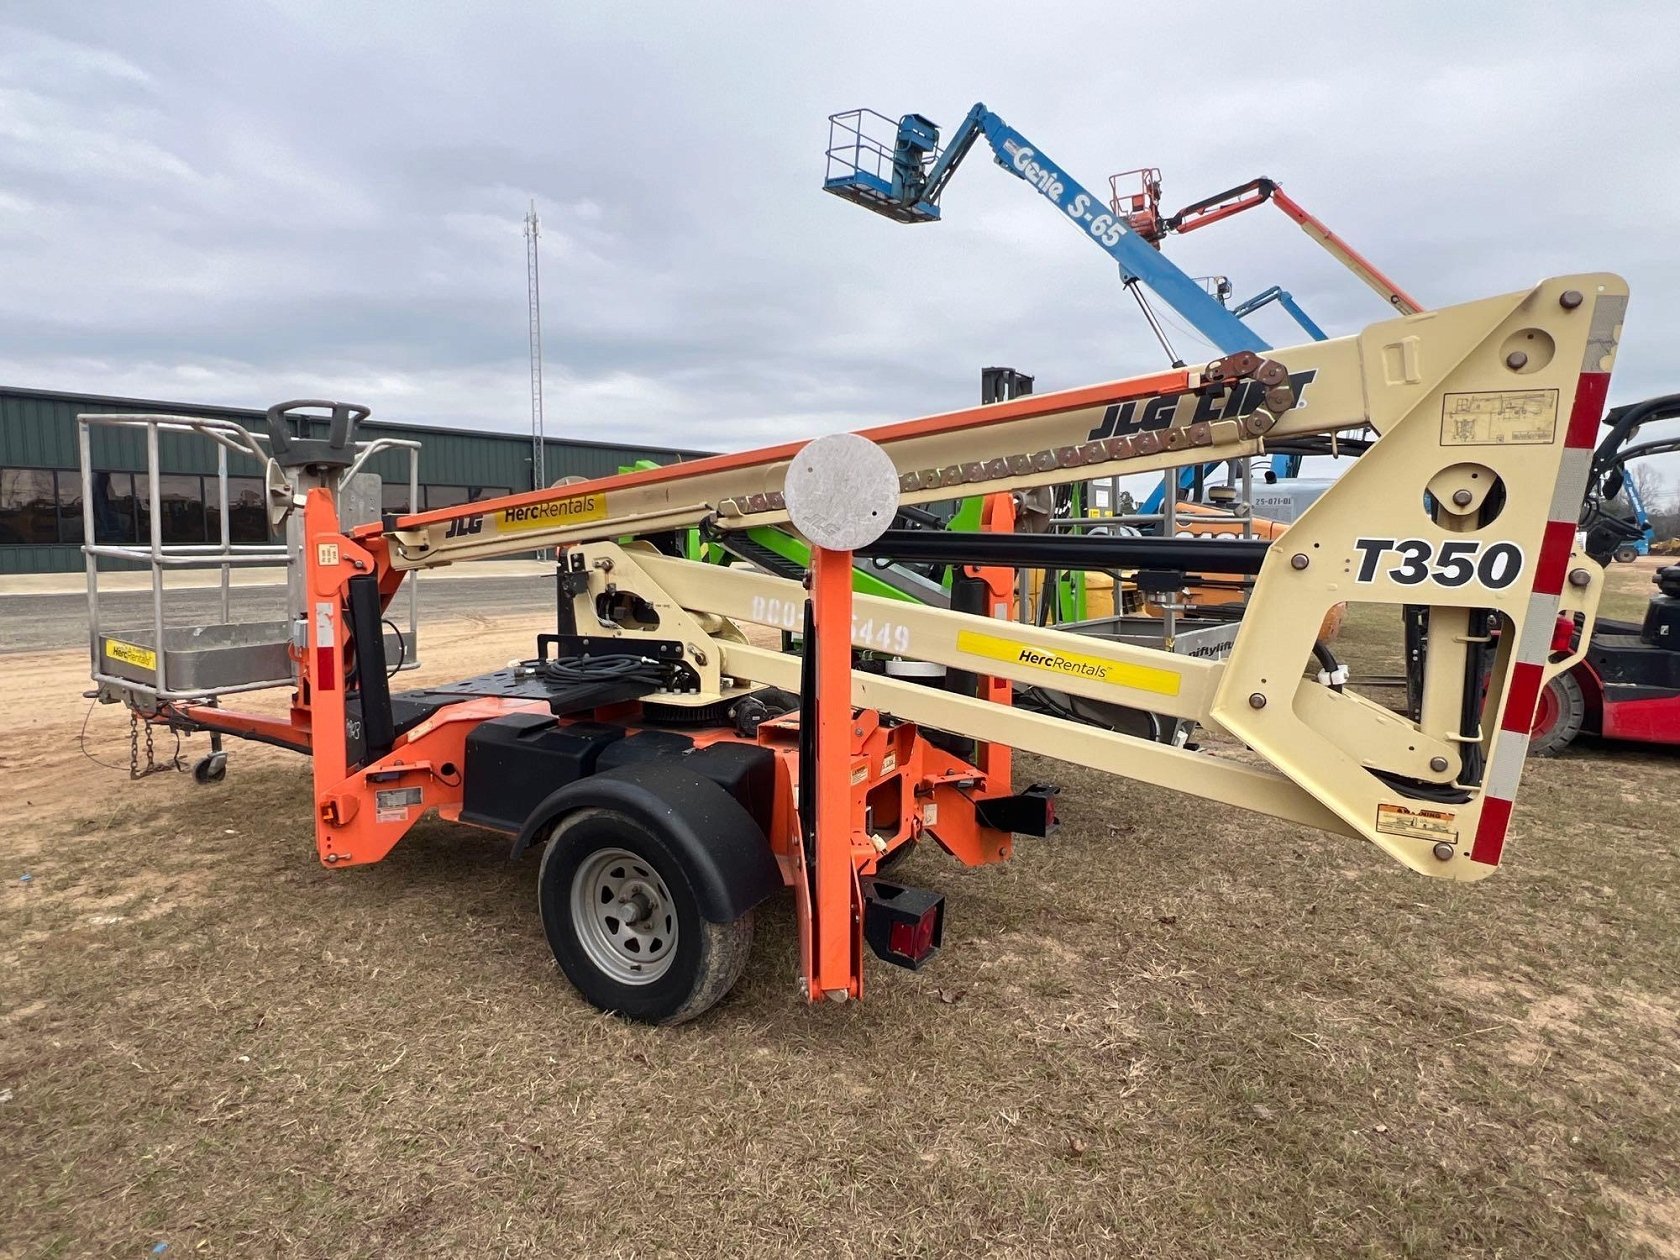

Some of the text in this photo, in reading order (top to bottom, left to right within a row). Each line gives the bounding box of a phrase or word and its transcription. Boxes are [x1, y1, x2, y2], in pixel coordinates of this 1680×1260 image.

[1014, 147, 1127, 246] Genie S-65
[1087, 394, 1182, 441] JLG
[445, 514, 484, 539] JLG
[505, 497, 595, 523] HercRentals
[1354, 538, 1525, 590] T350
[1019, 650, 1107, 678] HercRentals
